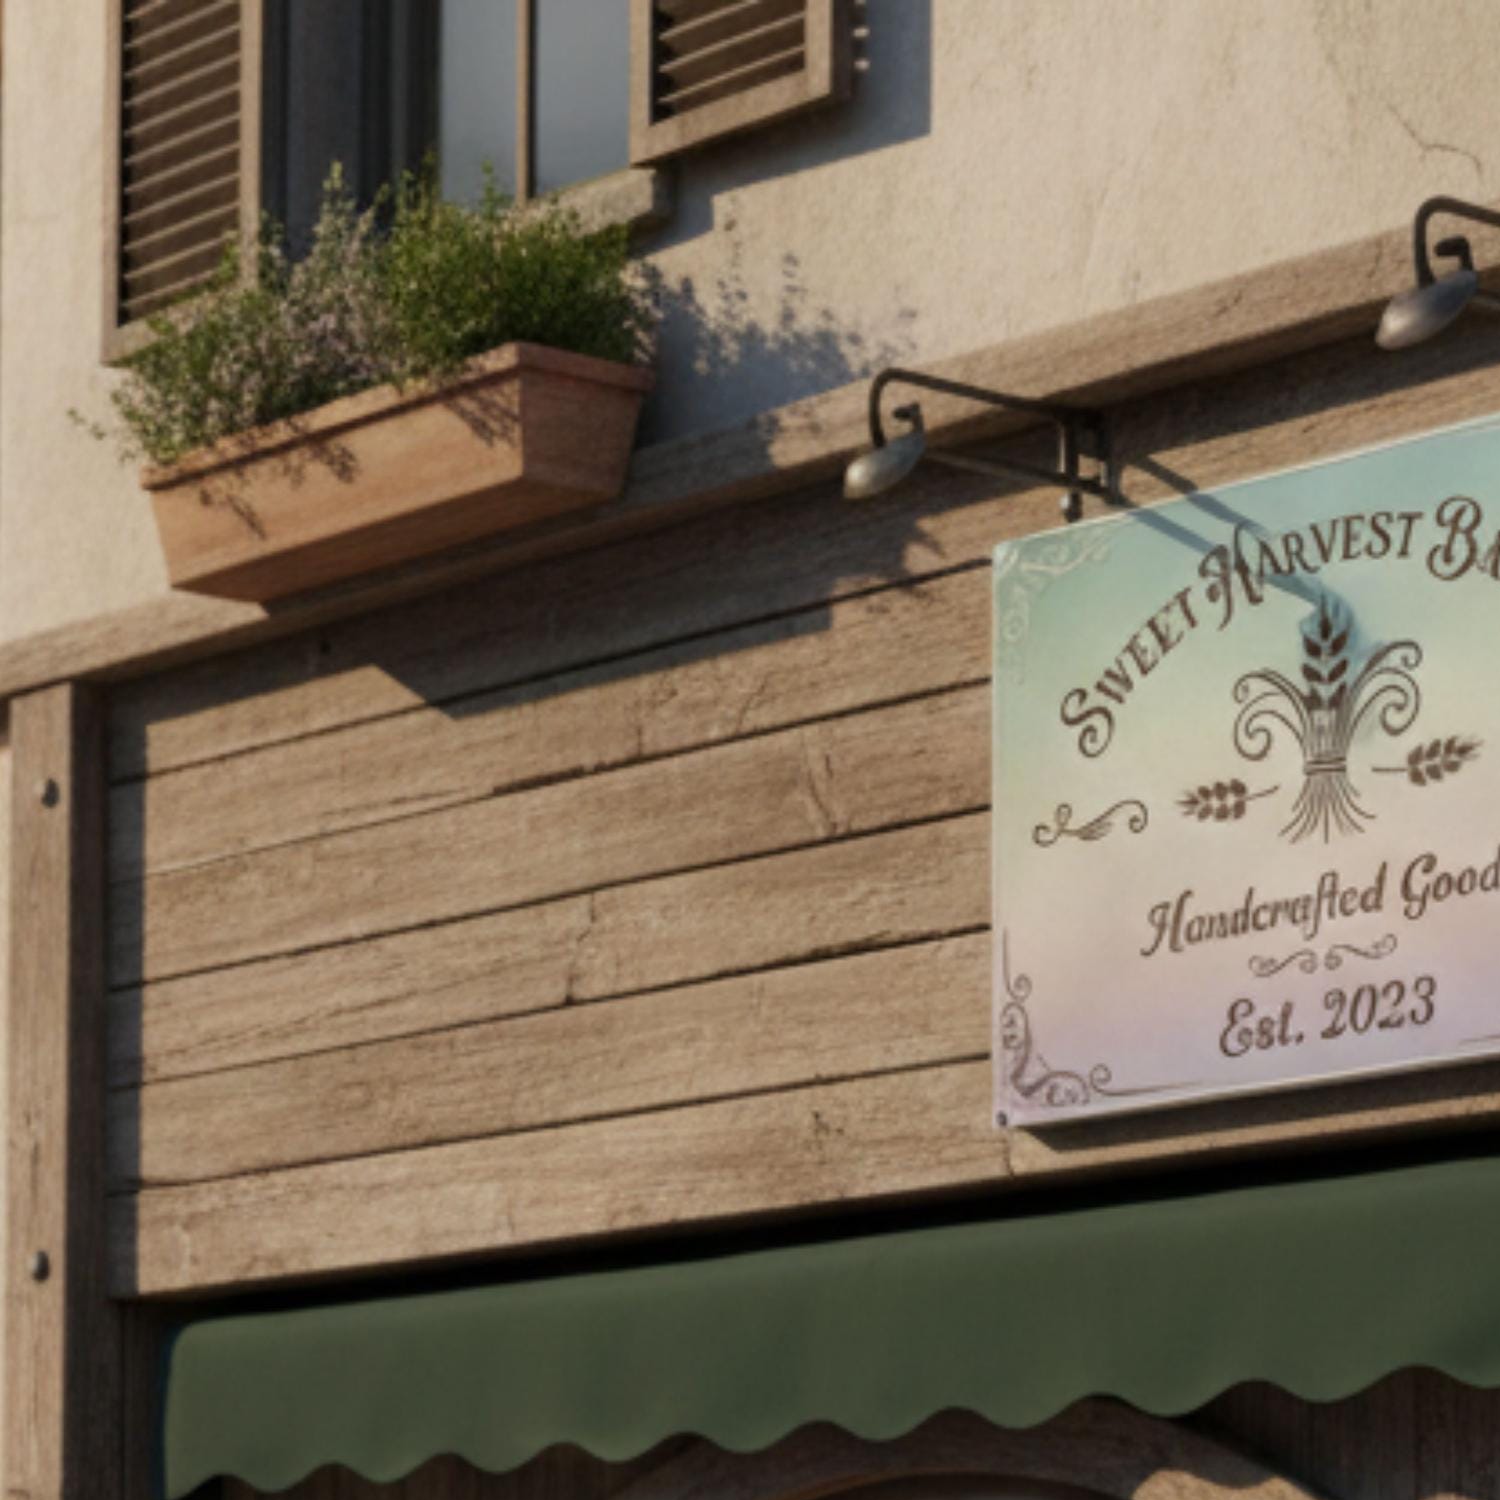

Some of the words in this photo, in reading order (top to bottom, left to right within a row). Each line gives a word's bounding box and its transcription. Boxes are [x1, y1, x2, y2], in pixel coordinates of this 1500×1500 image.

[1060, 587, 1198, 758] SWEET
[1198, 511, 1424, 631] HARVEST
[1140, 861, 1388, 957] Handcrafted
[1219, 998, 1305, 1058] Est.
[1321, 976, 1438, 1041] 2023
